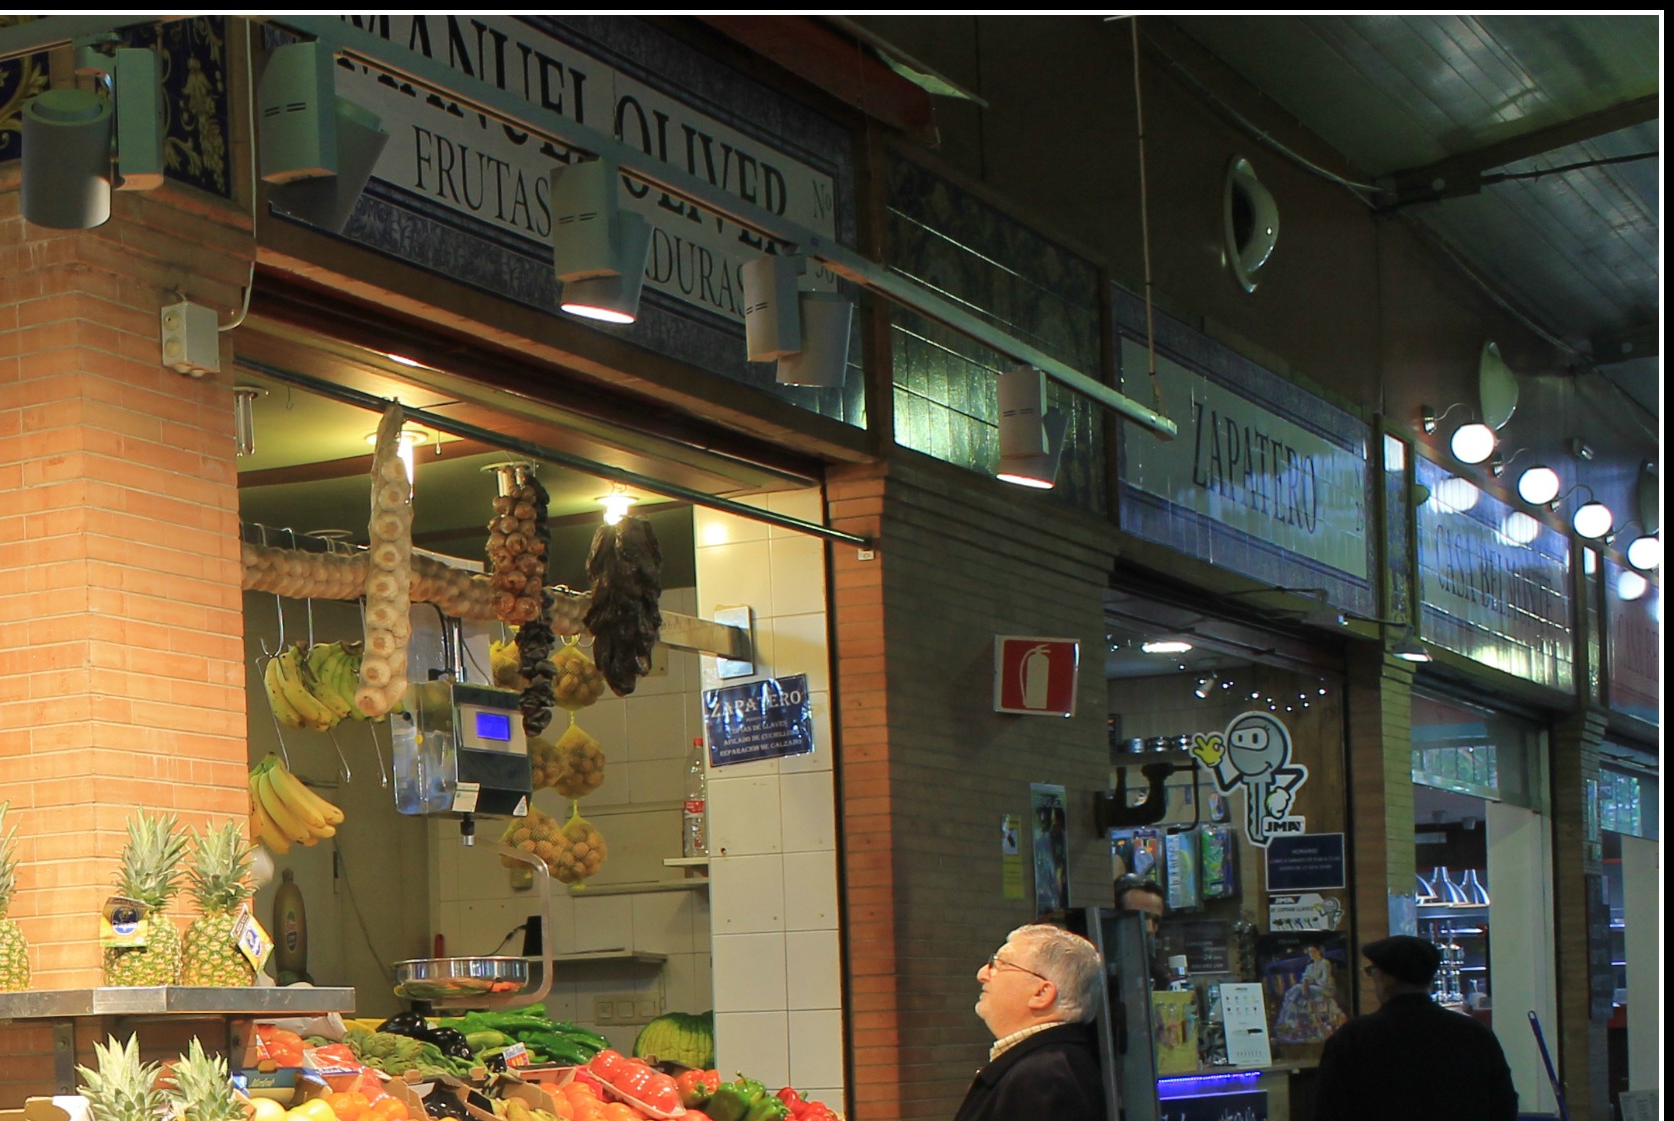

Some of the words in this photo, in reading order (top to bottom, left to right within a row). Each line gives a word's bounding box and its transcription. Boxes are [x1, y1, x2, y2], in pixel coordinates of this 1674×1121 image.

[412, 124, 554, 239] FRUTAS
[1191, 400, 1317, 534] ZAPATERO
[711, 690, 802, 718] ZAPATERO
